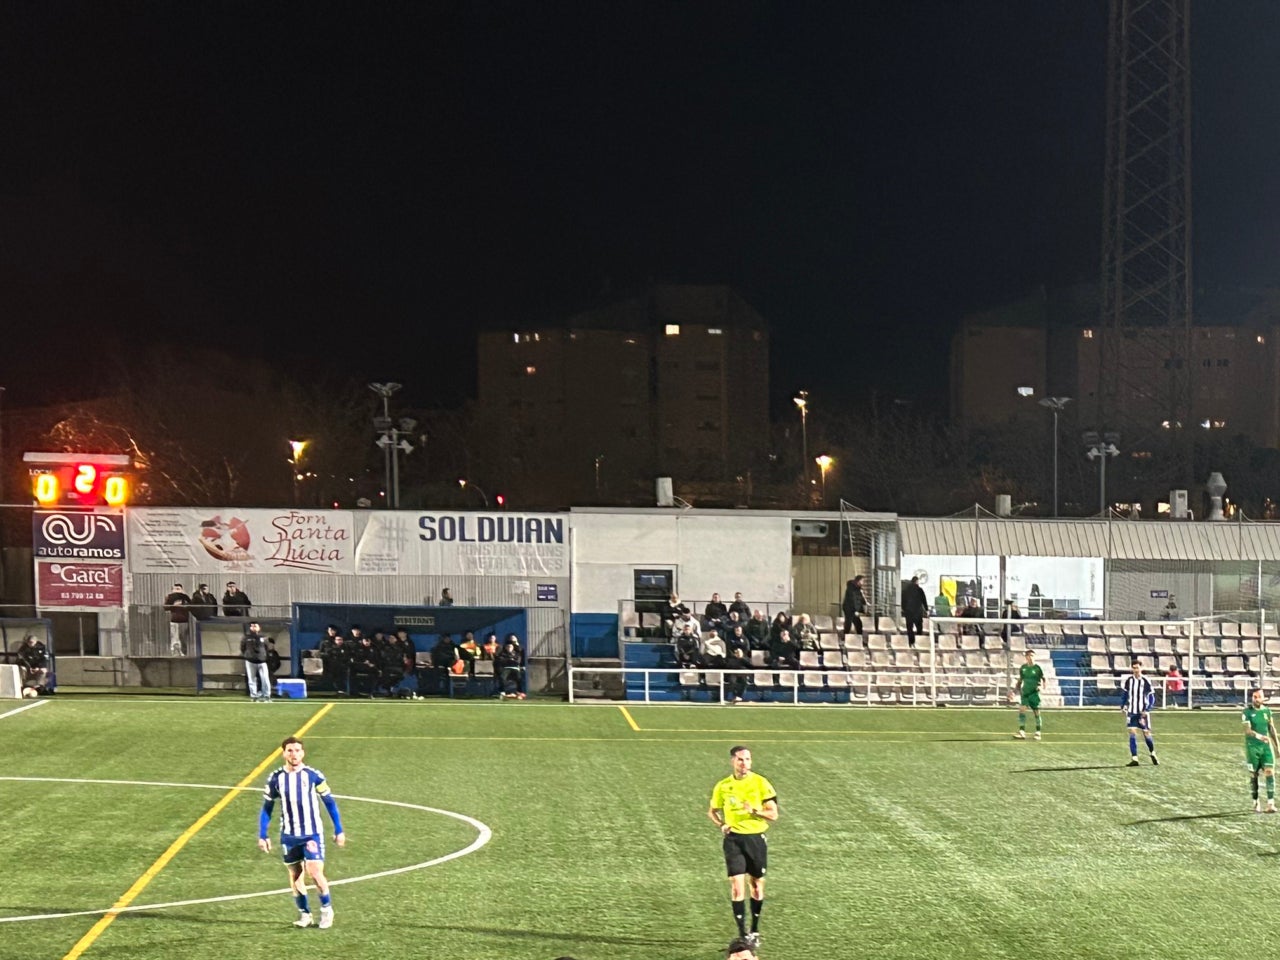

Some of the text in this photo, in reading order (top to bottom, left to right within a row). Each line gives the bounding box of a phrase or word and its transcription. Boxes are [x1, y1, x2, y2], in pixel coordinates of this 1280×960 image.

[37, 465, 127, 504] 0 2 0
[283, 511, 326, 526] Forn
[263, 516, 349, 543] Santa
[38, 547, 121, 557] autoramos
[60, 565, 112, 583] Garel
